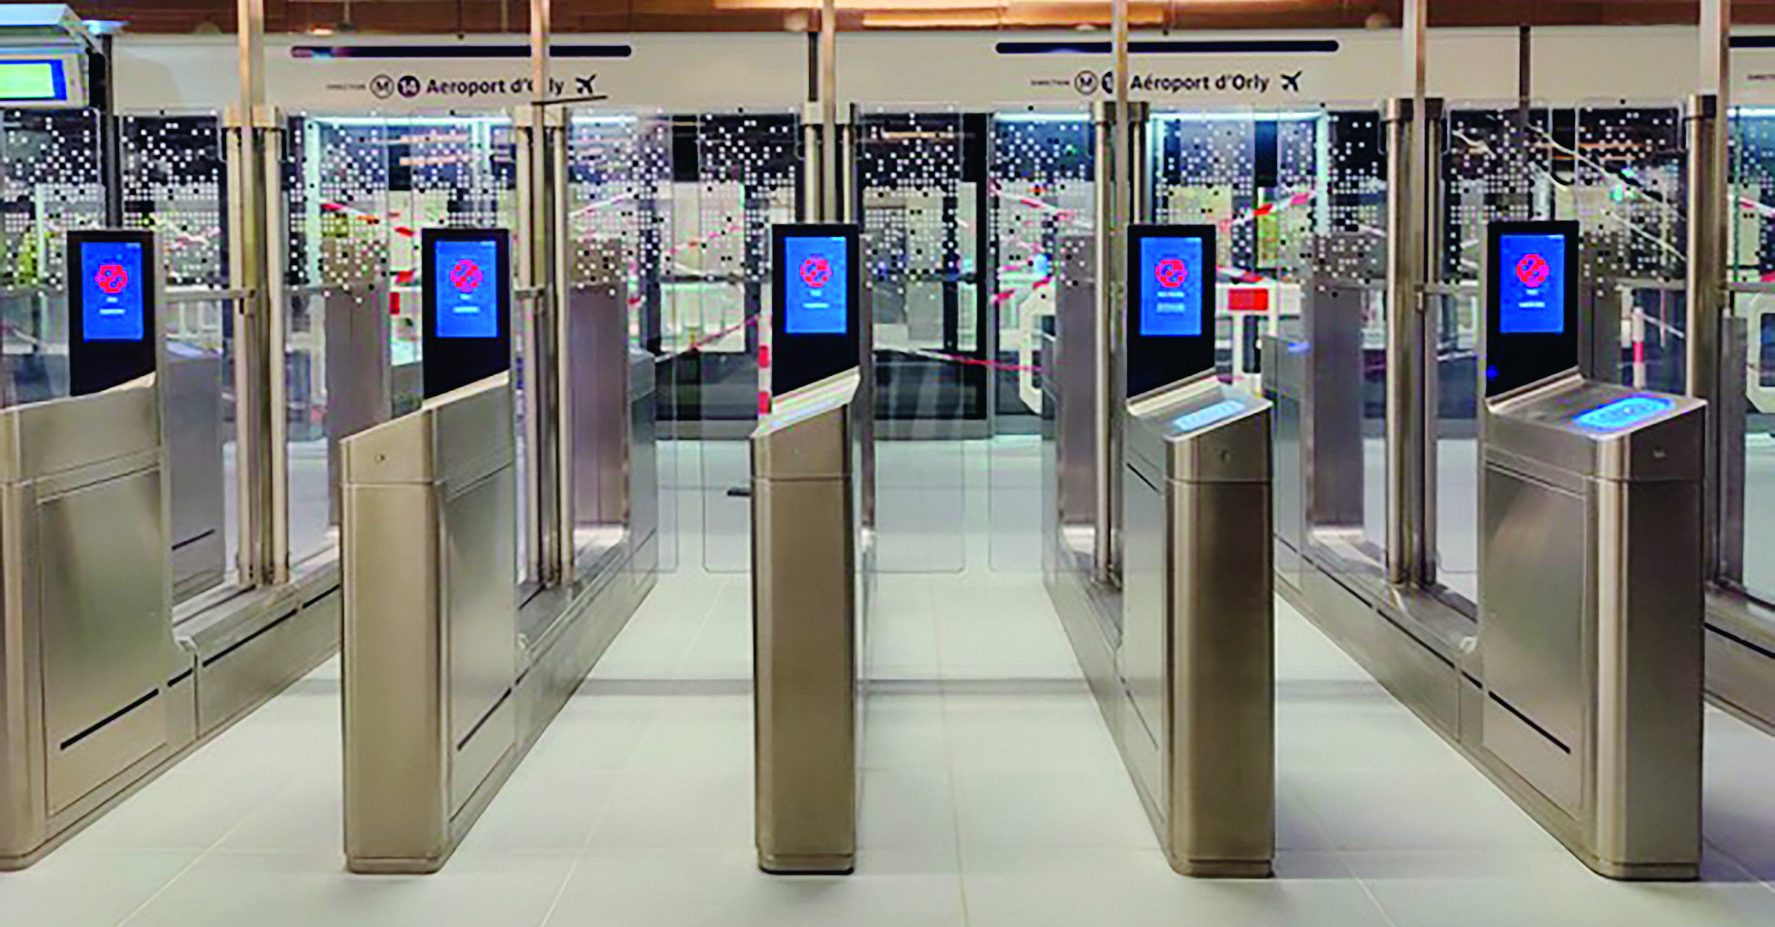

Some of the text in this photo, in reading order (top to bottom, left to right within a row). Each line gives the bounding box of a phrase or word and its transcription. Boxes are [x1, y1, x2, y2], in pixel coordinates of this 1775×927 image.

[510, 77, 565, 96] d'ly
[1130, 73, 1210, 93] Aéroport
[1215, 74, 1269, 93] d'Orly
